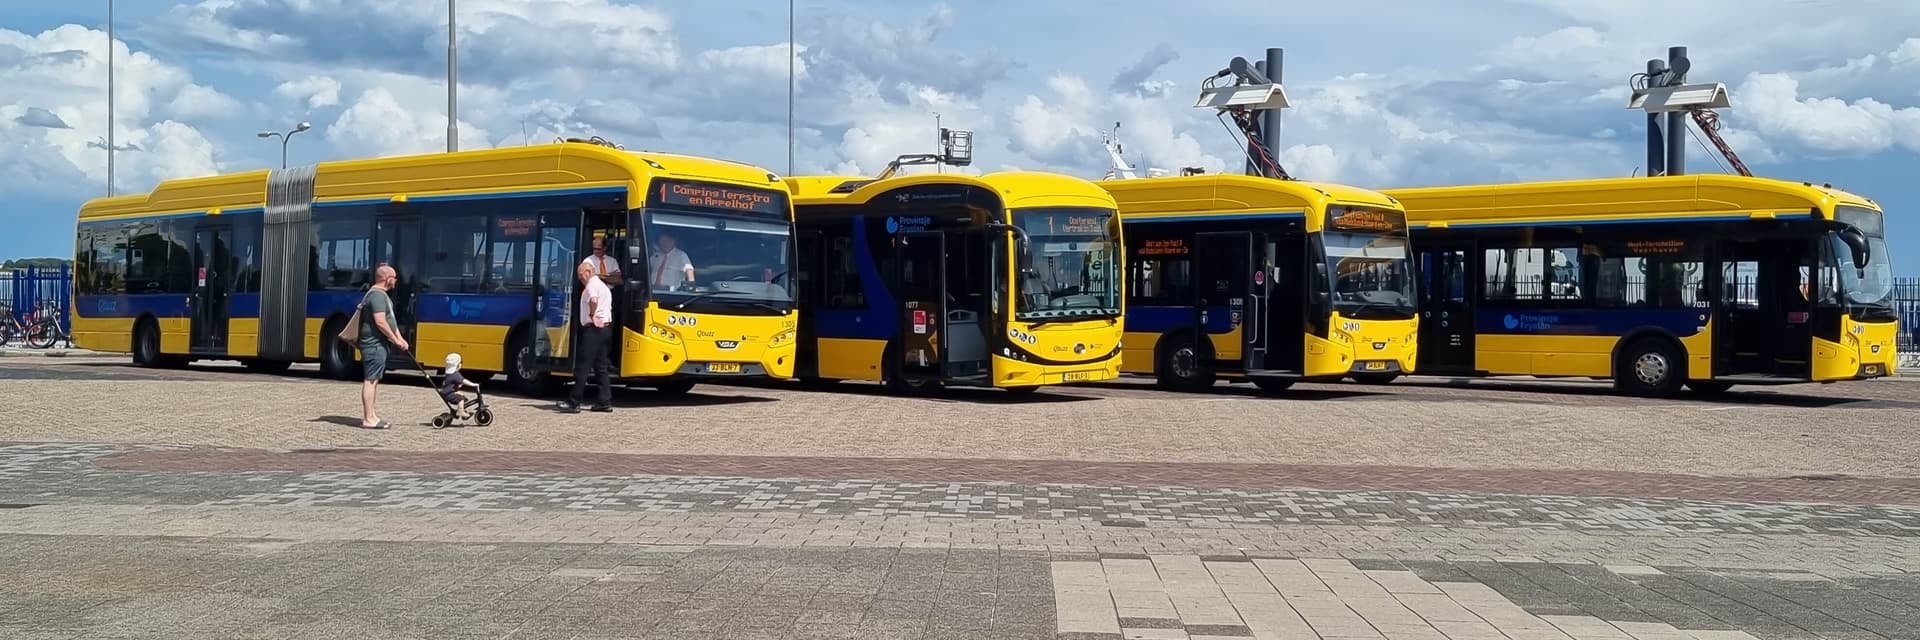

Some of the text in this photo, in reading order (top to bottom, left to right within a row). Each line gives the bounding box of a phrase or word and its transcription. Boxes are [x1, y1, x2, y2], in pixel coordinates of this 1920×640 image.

[660, 183, 667, 203] 1
[673, 184, 719, 198] Camping
[689, 196, 703, 205] en
